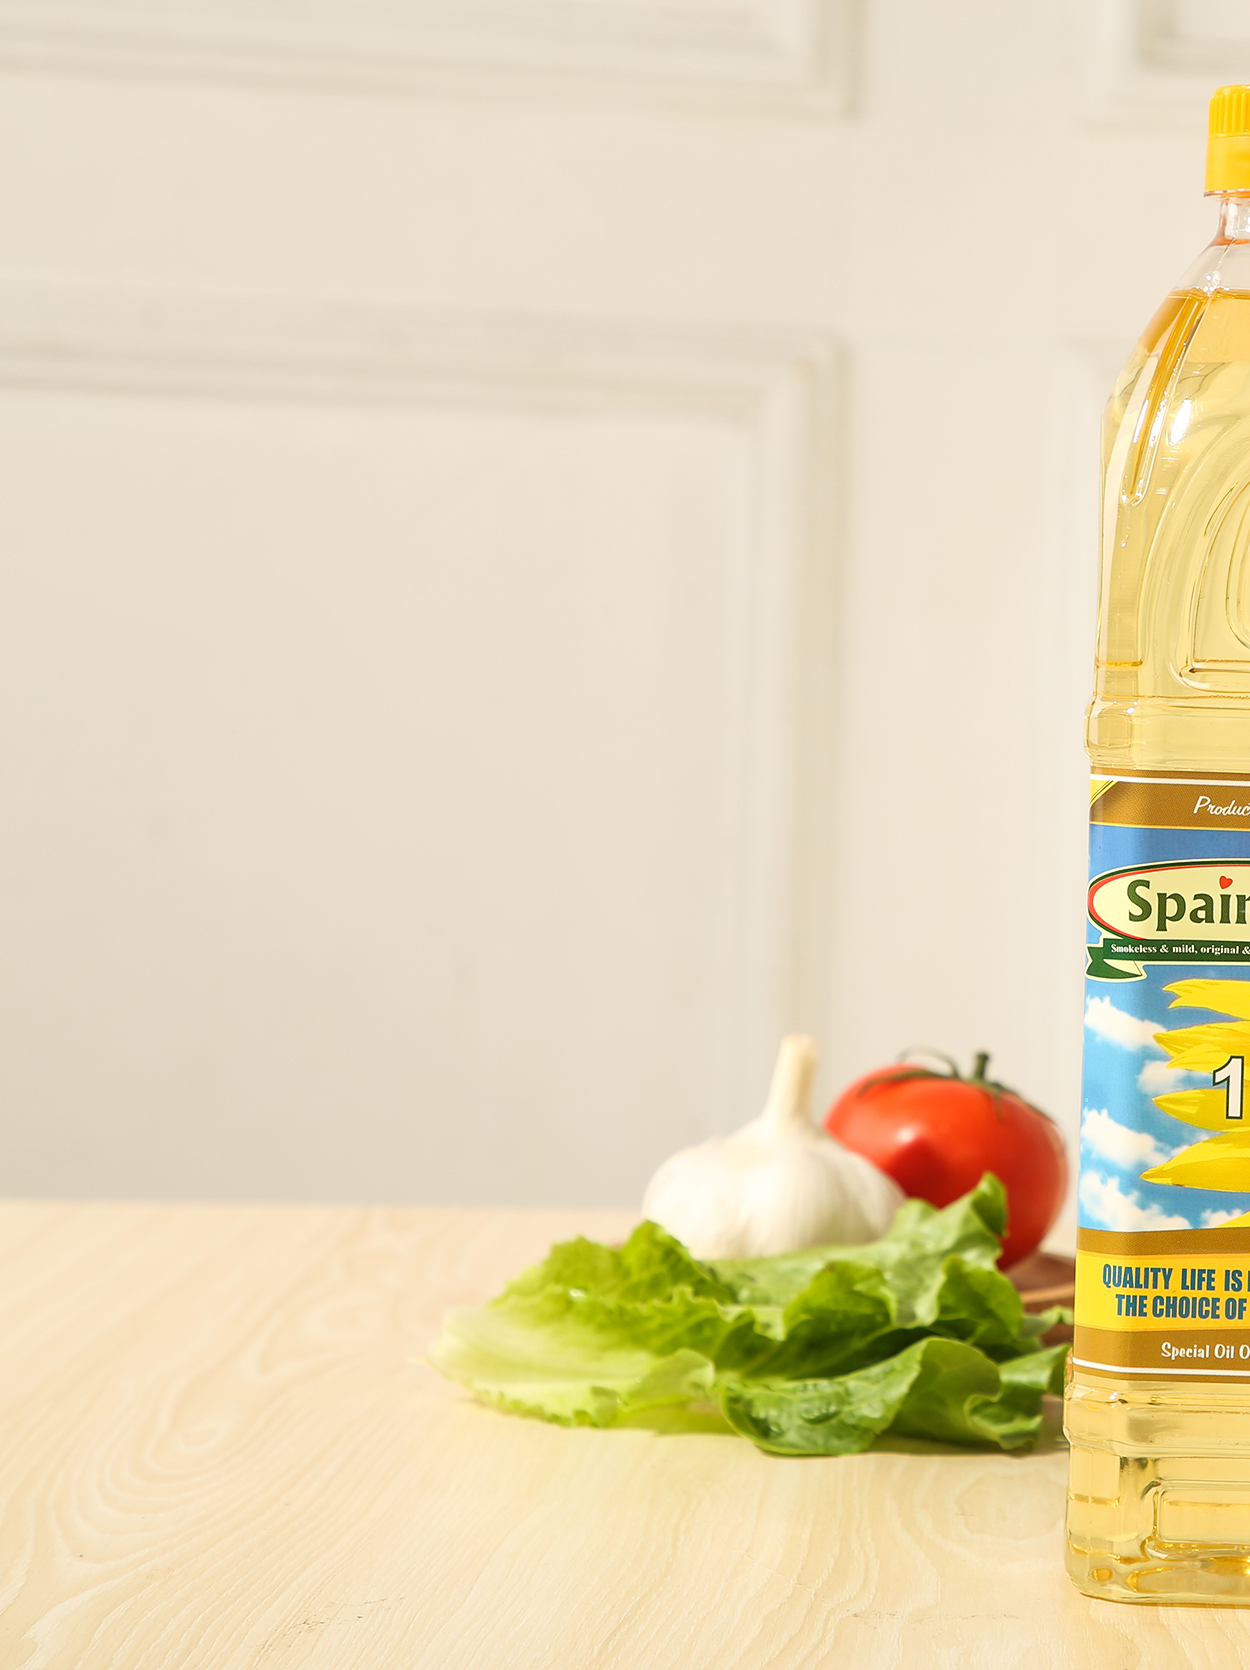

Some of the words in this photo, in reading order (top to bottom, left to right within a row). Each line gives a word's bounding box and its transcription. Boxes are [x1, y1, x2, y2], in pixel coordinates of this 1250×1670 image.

[1111, 943, 1157, 954] Smokeless
[1159, 944, 1169, 953] &
[1172, 944, 1198, 955] mild,
[1200, 944, 1240, 956] original
[1102, 1263, 1174, 1290] QUALITY
[1180, 1268, 1216, 1292] LIFE
[1223, 1269, 1243, 1292] IS
[1115, 1294, 1148, 1317] THE
[1151, 1295, 1221, 1320] CHOICE
[1224, 1297, 1248, 1320] OF
[1160, 1341, 1210, 1361] Special
[1214, 1343, 1235, 1359] Oil
